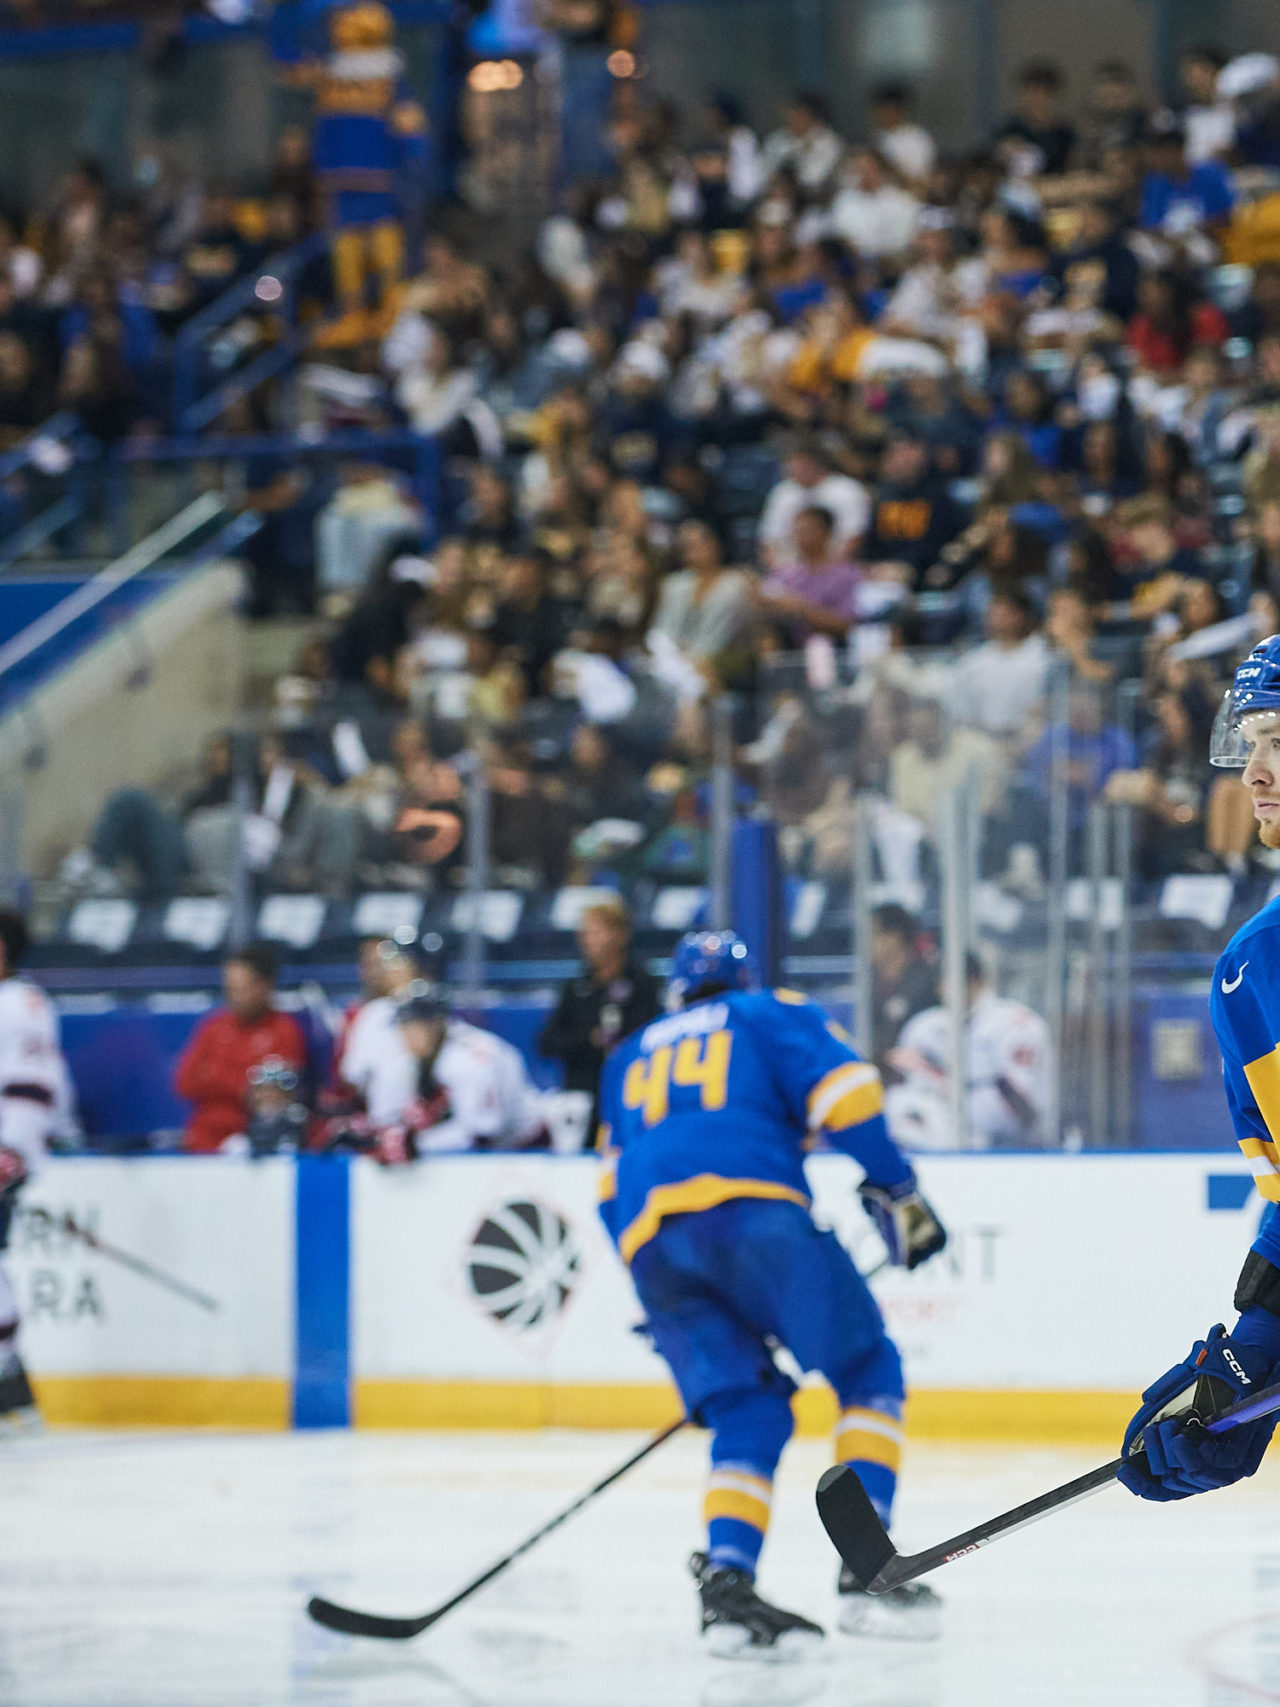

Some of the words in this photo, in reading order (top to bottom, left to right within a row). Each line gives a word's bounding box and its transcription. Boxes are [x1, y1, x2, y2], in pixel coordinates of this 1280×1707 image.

[622, 1028, 733, 1129] 44
[1222, 1348, 1252, 1385] CCM
[945, 1544, 977, 1562] CCM
